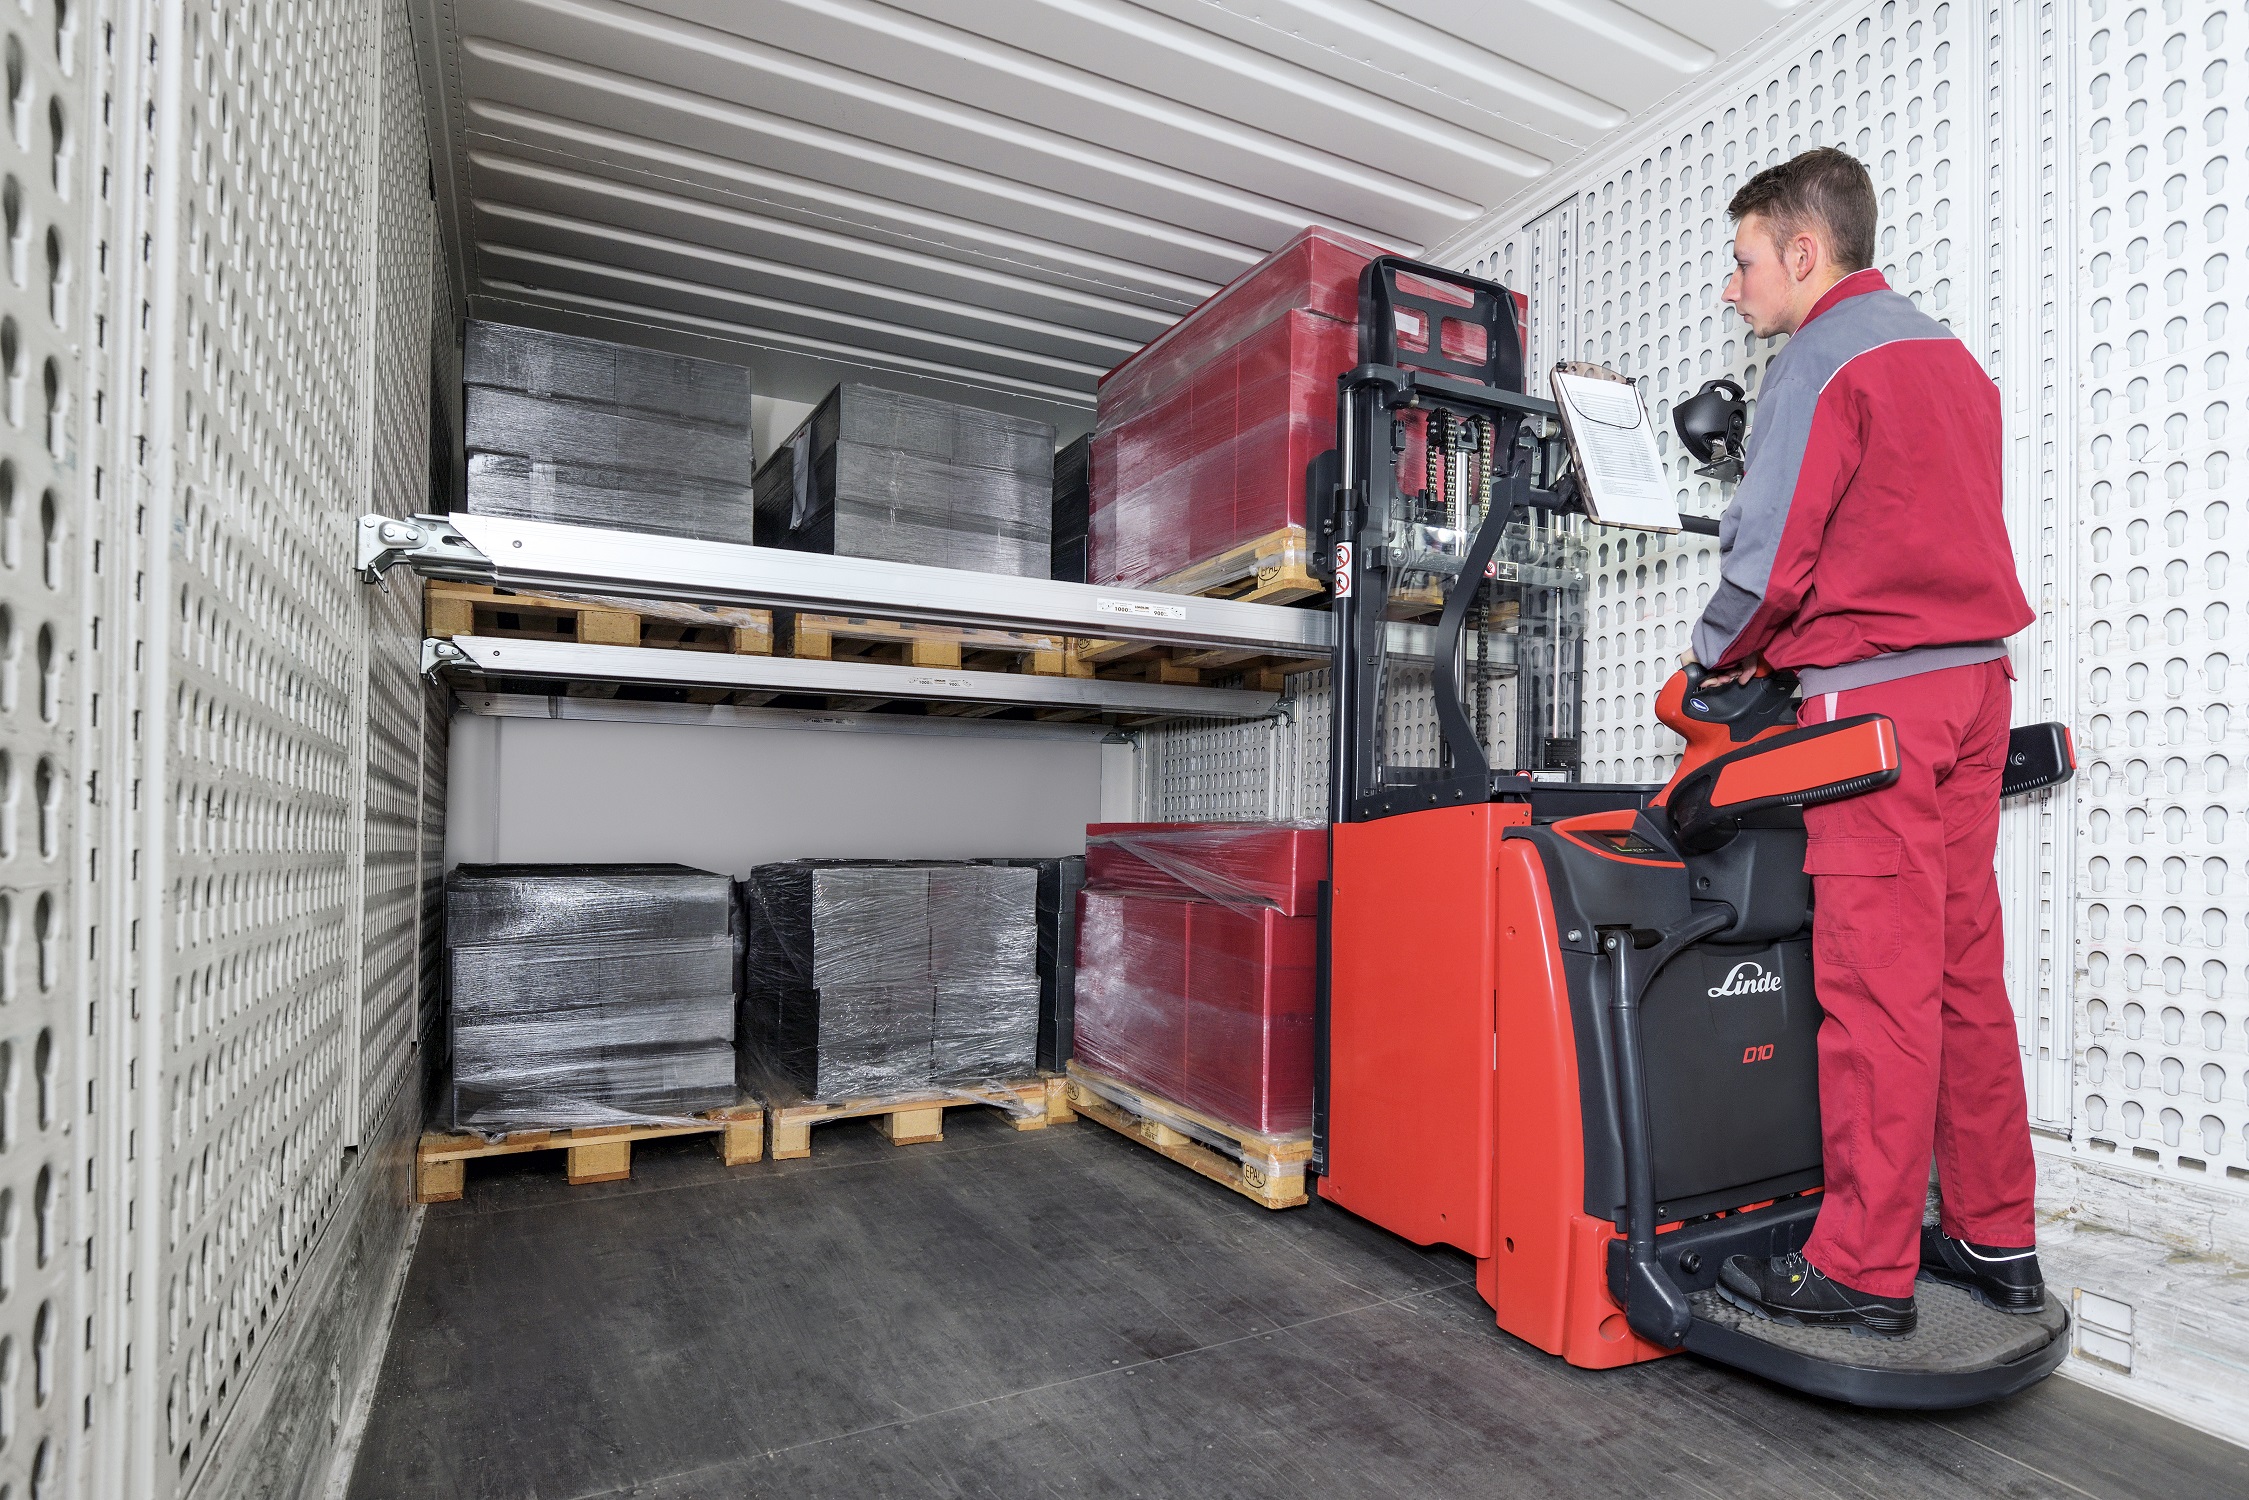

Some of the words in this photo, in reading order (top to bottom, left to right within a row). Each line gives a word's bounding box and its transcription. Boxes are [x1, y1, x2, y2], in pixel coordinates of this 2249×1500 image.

[1707, 961, 1782, 998] Linde
[1742, 1043, 1775, 1064] D10
[1245, 1164, 1263, 1185] EPAL
